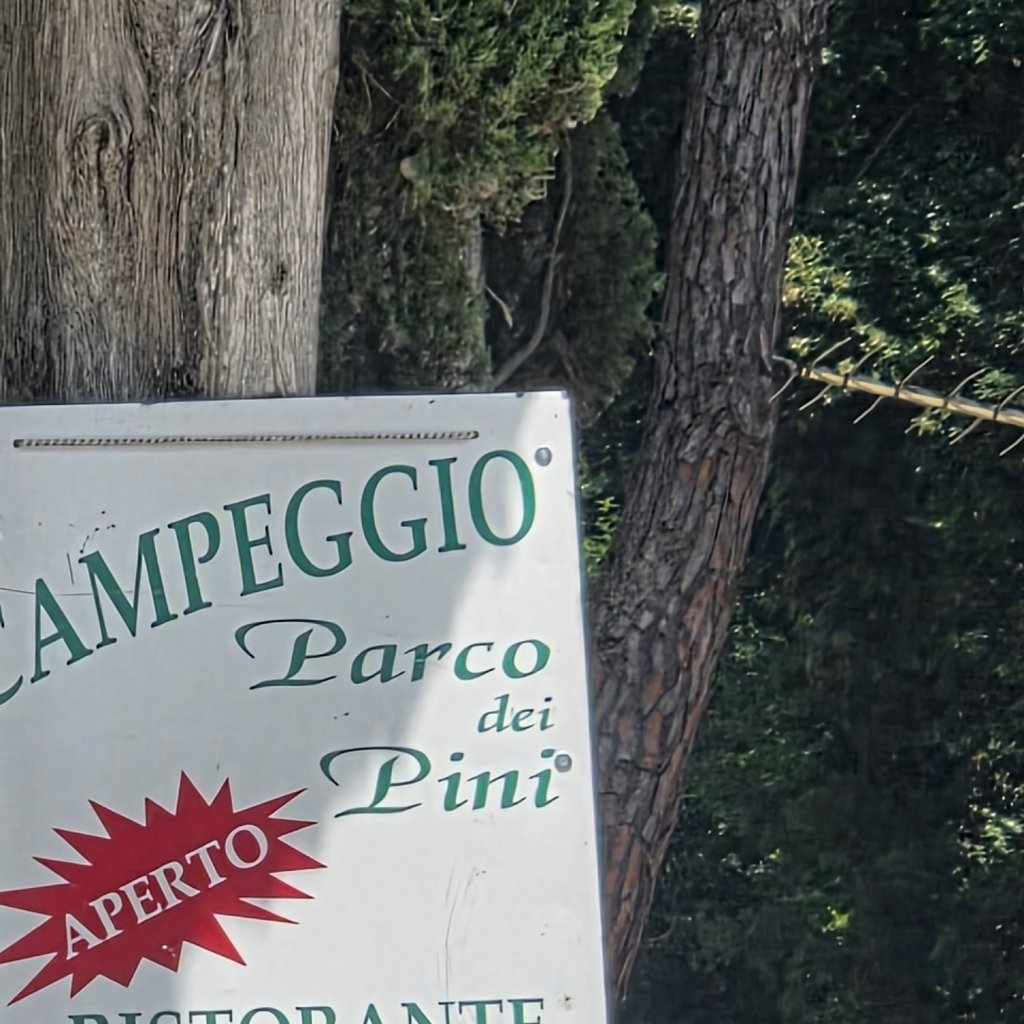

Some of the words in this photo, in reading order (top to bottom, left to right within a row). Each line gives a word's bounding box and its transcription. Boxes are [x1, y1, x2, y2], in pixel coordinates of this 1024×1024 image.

[235, 619, 551, 690] Parco
[478, 694, 555, 733] dei
[320, 746, 562, 818] Pini
[63, 824, 269, 960] APERTO
